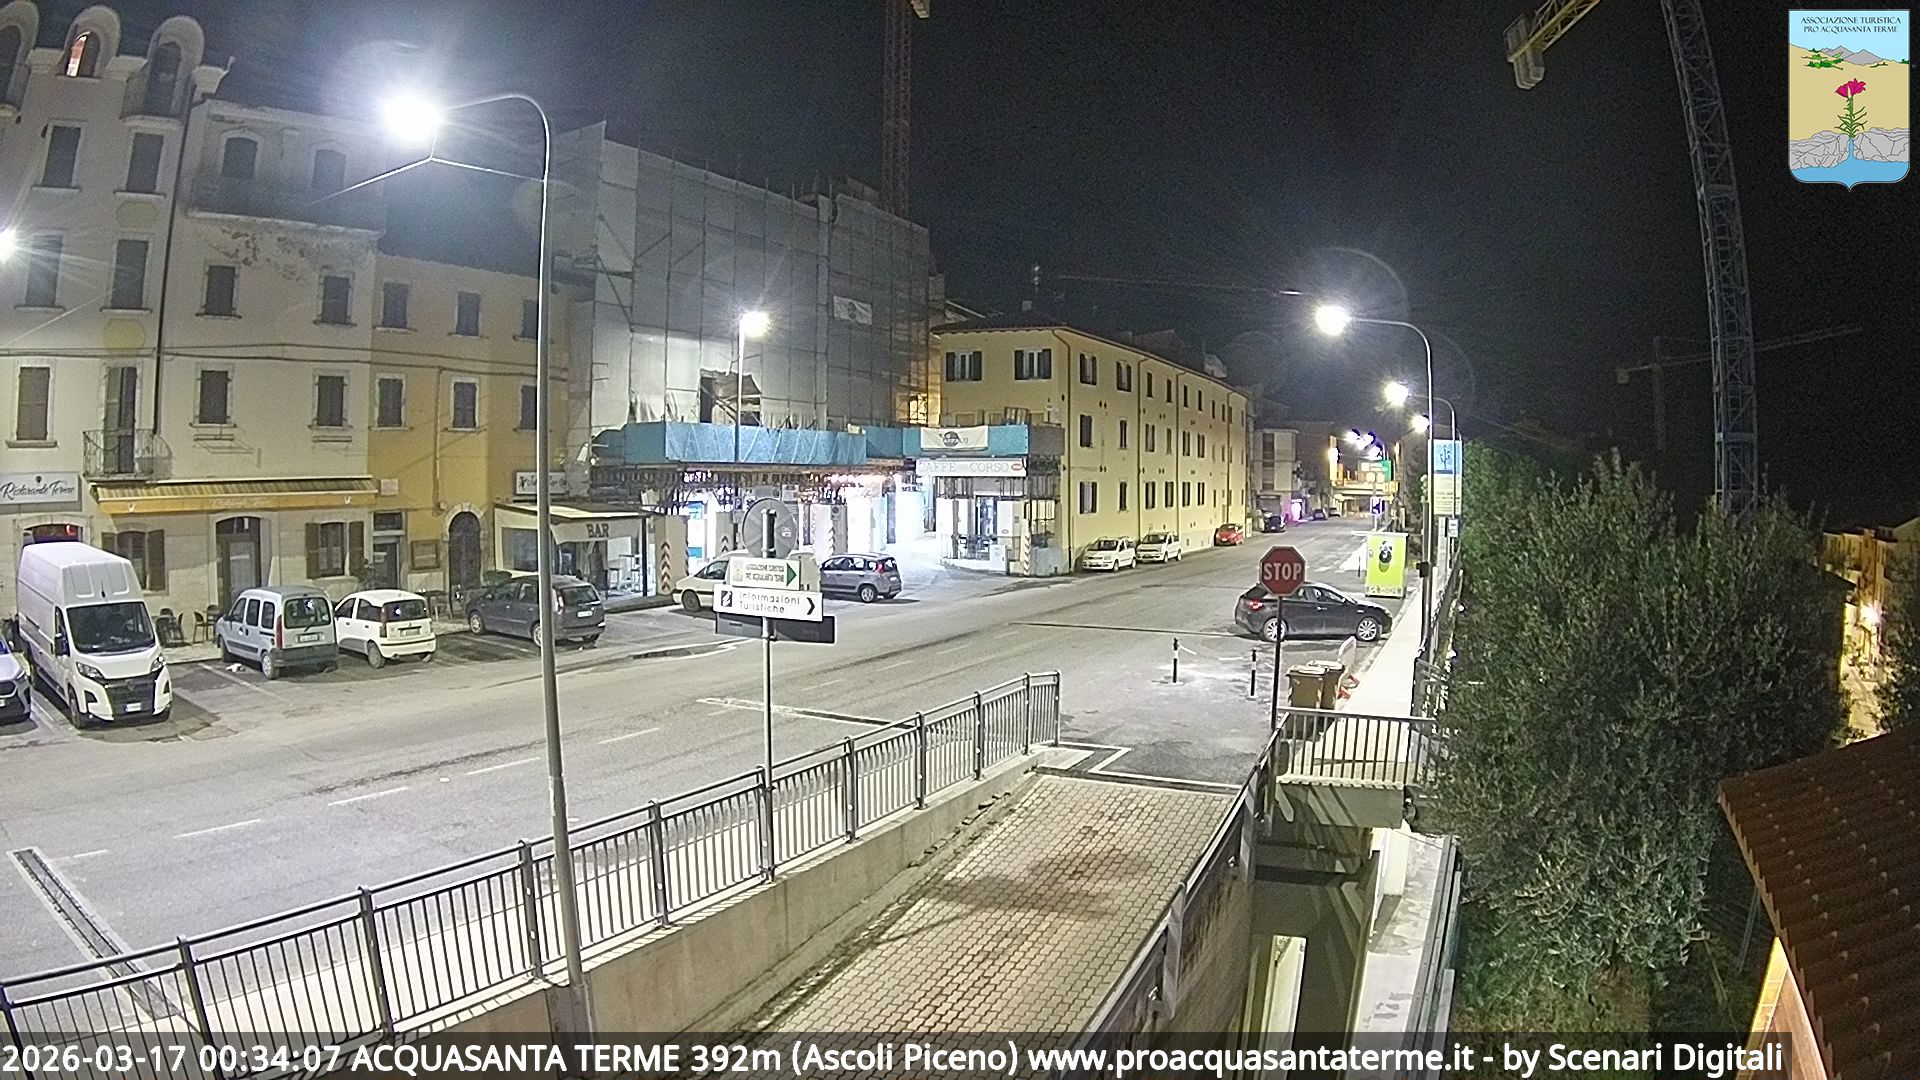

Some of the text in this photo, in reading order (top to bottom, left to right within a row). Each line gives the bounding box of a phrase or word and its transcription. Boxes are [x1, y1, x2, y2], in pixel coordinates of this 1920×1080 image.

[969, 462, 1009, 473] CORSO
[586, 523, 609, 538] BAR
[1263, 562, 1302, 581] STOP
[739, 591, 800, 605] Informazioni
[739, 600, 785, 614] Turistiche
